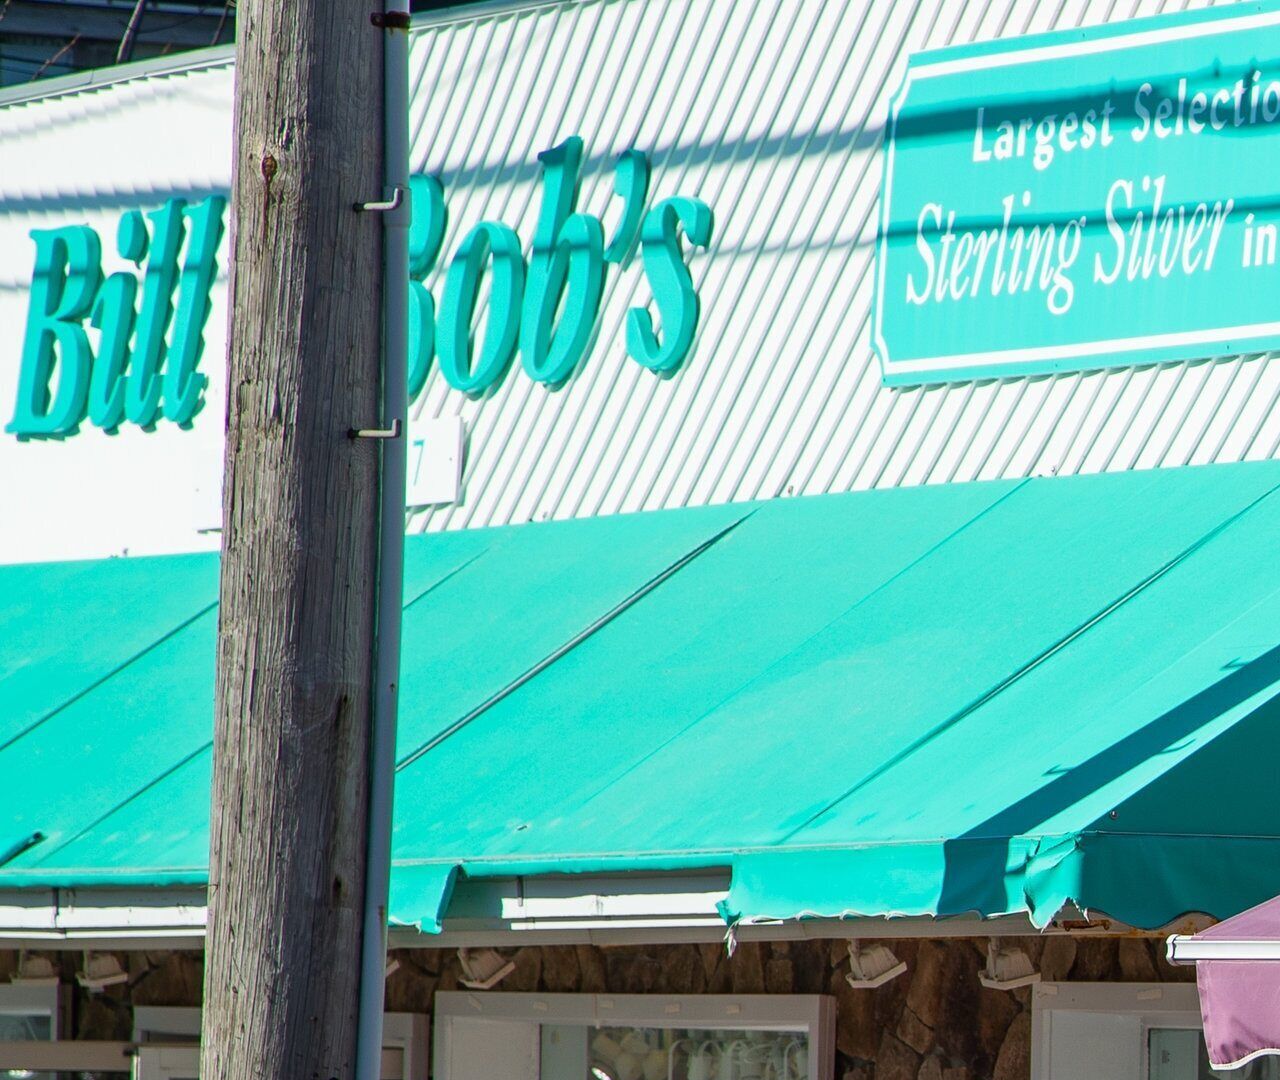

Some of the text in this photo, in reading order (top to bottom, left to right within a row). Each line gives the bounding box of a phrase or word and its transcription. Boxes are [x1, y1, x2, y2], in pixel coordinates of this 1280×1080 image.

[973, 100, 1115, 171] Largest
[905, 190, 1088, 315] Sterling
[1094, 175, 1235, 286] Silver
[1242, 214, 1277, 270] in
[5, 197, 226, 440] Bill
